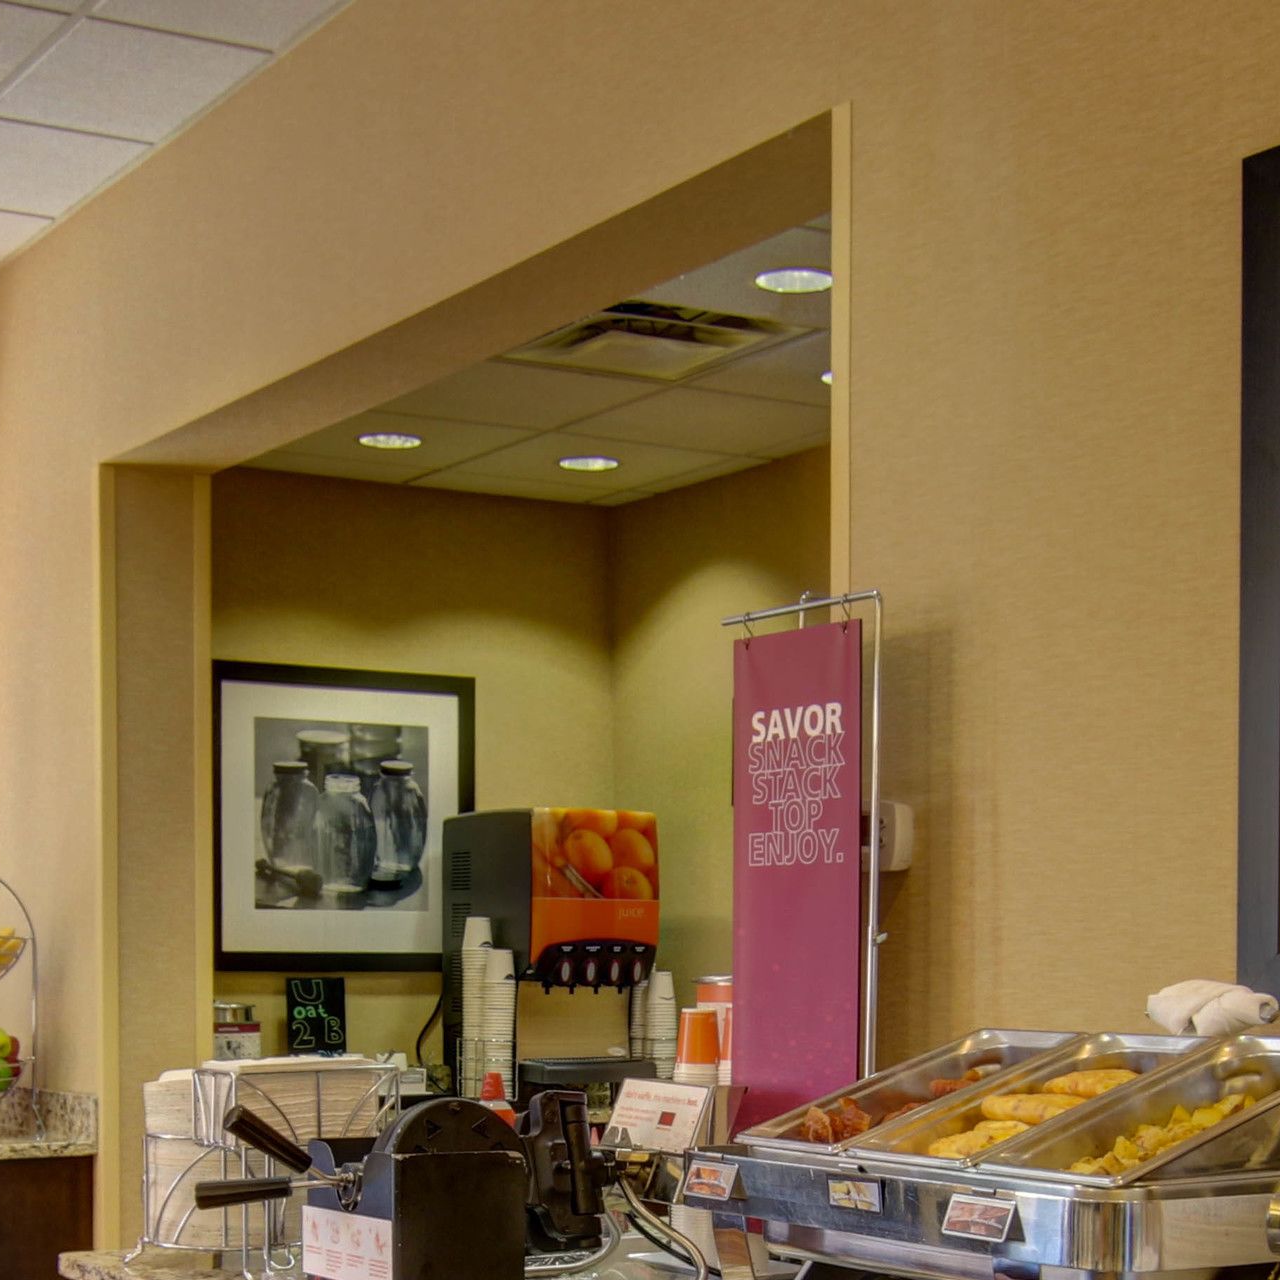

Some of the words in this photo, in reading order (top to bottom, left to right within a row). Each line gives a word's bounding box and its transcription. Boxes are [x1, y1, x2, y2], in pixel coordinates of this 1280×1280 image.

[751, 702, 843, 743] SAVOR
[748, 731, 846, 774] SNACK
[752, 765, 842, 805] STACK
[768, 798, 824, 833] TOP
[748, 828, 845, 867] ENJOY.
[291, 979, 324, 1005] U
[293, 1004, 328, 1019] oat
[292, 1020, 315, 1049] 2
[325, 1016, 344, 1044] B
